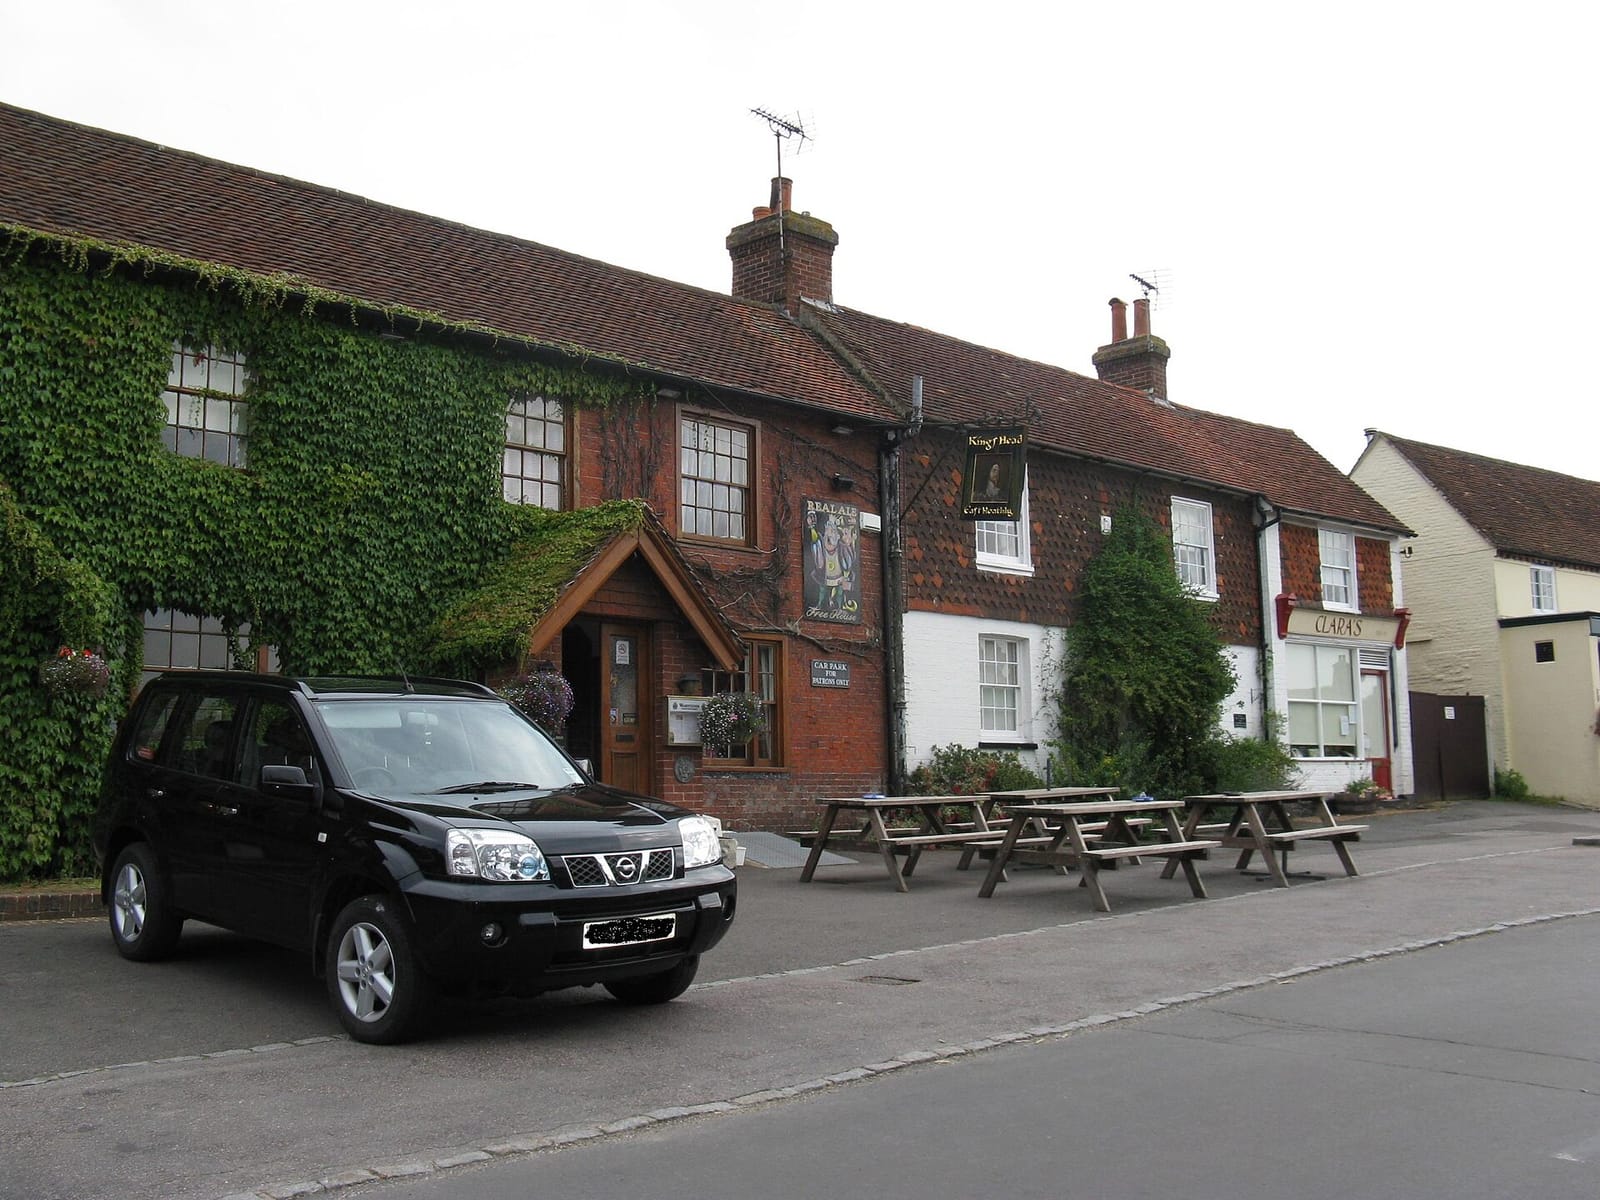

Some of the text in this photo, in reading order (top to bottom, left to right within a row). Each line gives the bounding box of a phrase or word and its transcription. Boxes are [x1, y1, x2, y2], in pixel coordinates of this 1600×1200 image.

[999, 434, 1023, 445] Head
[807, 500, 858, 517] REAL ALE
[806, 606, 857, 621] Free House
[1315, 615, 1362, 637] CLARA'S
[814, 661, 848, 671] CAR PARK
[812, 677, 835, 685] PATRONS
